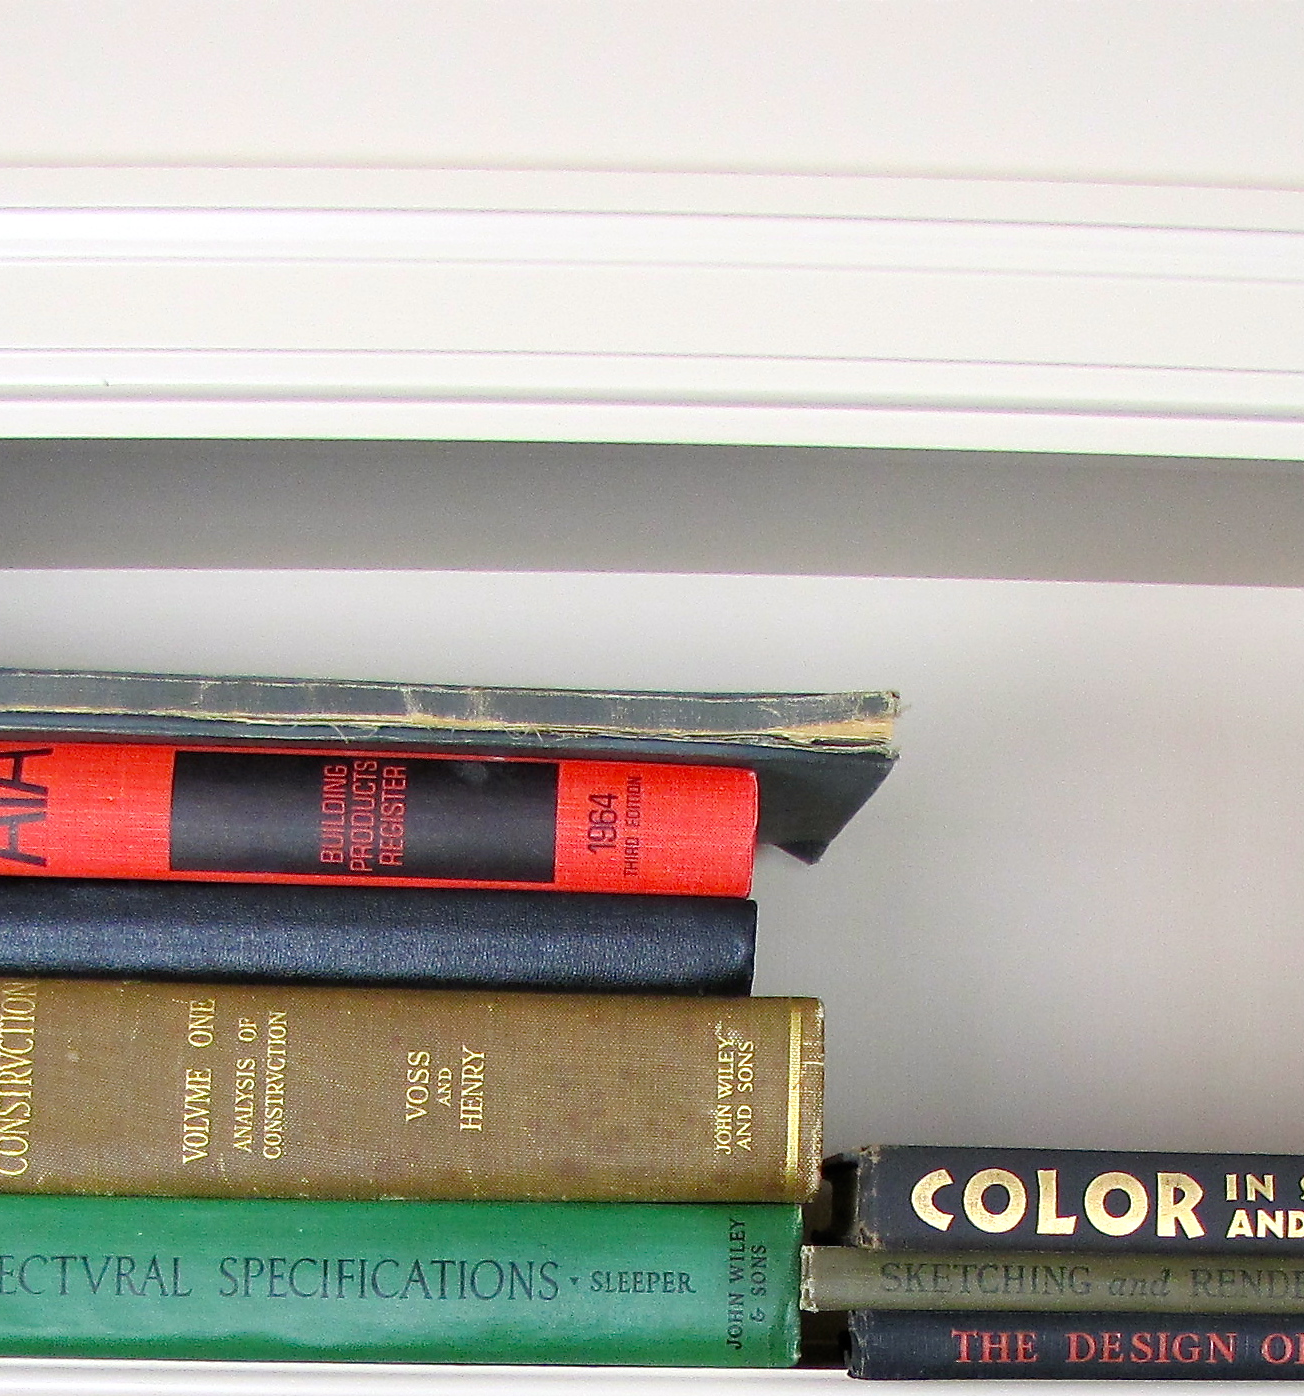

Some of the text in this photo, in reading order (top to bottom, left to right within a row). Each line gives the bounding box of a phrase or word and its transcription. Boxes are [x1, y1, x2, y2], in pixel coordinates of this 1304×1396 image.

[320, 764, 348, 865] BUILDING
[350, 759, 379, 873] PRODUCTS
[378, 765, 409, 867] REGISTER
[586, 791, 619, 854] 1964
[623, 836, 640, 878] THIRD
[187, 997, 216, 1049] ONE
[233, 1057, 256, 1153] ANALYSIS
[405, 1049, 432, 1123] VOSS
[437, 1066, 453, 1108] AND
[459, 1044, 487, 1132] HENRY
[714, 1102, 733, 1155] JOHN
[735, 1104, 753, 1151] AND
[909, 1167, 1206, 1239] COLOR
[1224, 1172, 1275, 1202] IN
[218, 1255, 560, 1301] SPECIFICATIONS
[589, 1270, 698, 1295] SLEEPER
[726, 1216, 747, 1350] JOHN WILEY
[751, 1242, 767, 1299] SONS
[879, 1261, 1092, 1298] SKETCHING
[1107, 1267, 1172, 1299] and
[950, 1329, 1040, 1364] THE
[1065, 1330, 1238, 1365] DESIGN
